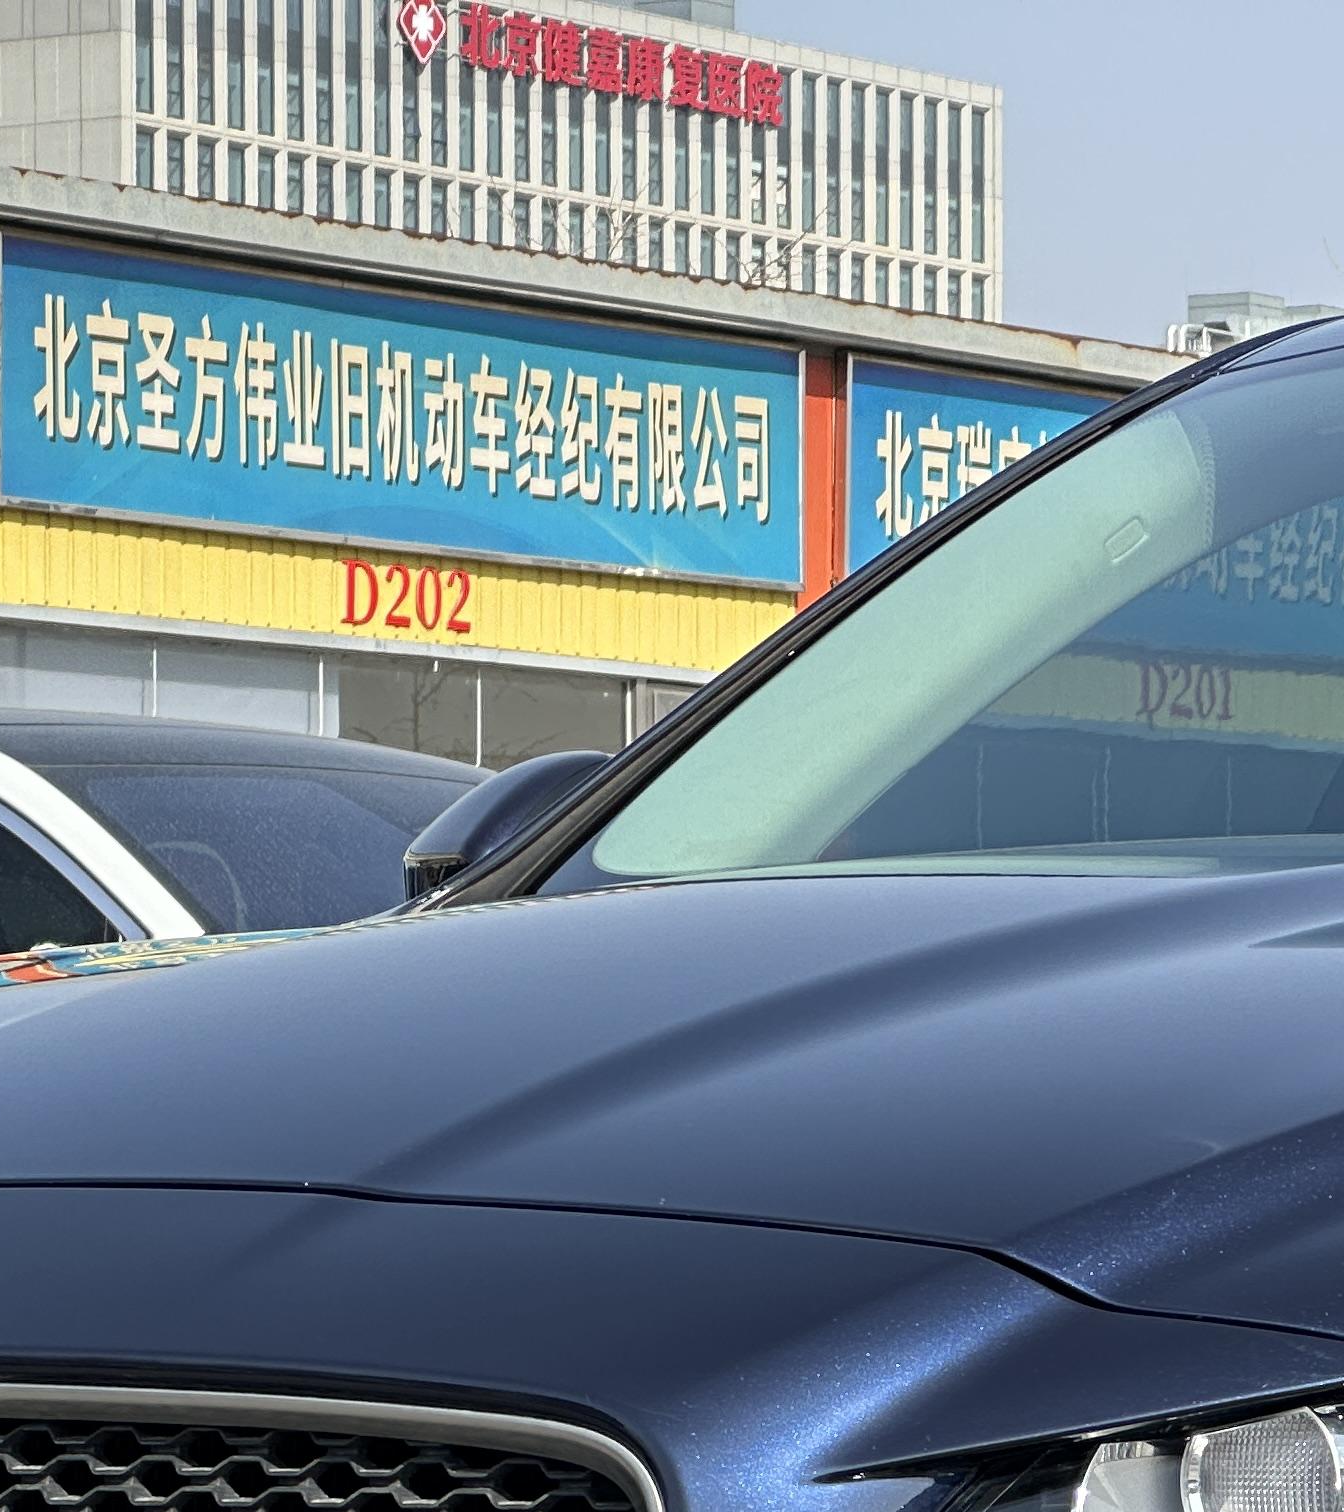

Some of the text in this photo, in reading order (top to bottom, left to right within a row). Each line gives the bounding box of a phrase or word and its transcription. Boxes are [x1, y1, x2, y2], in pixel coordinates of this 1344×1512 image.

[460, 3, 784, 127] 北京健嘉康复医院
[33, 293, 771, 524] 北京圣方伟业旧机动车经纪有限公司
[343, 559, 473, 633] D202
[1137, 660, 1235, 722] D201
